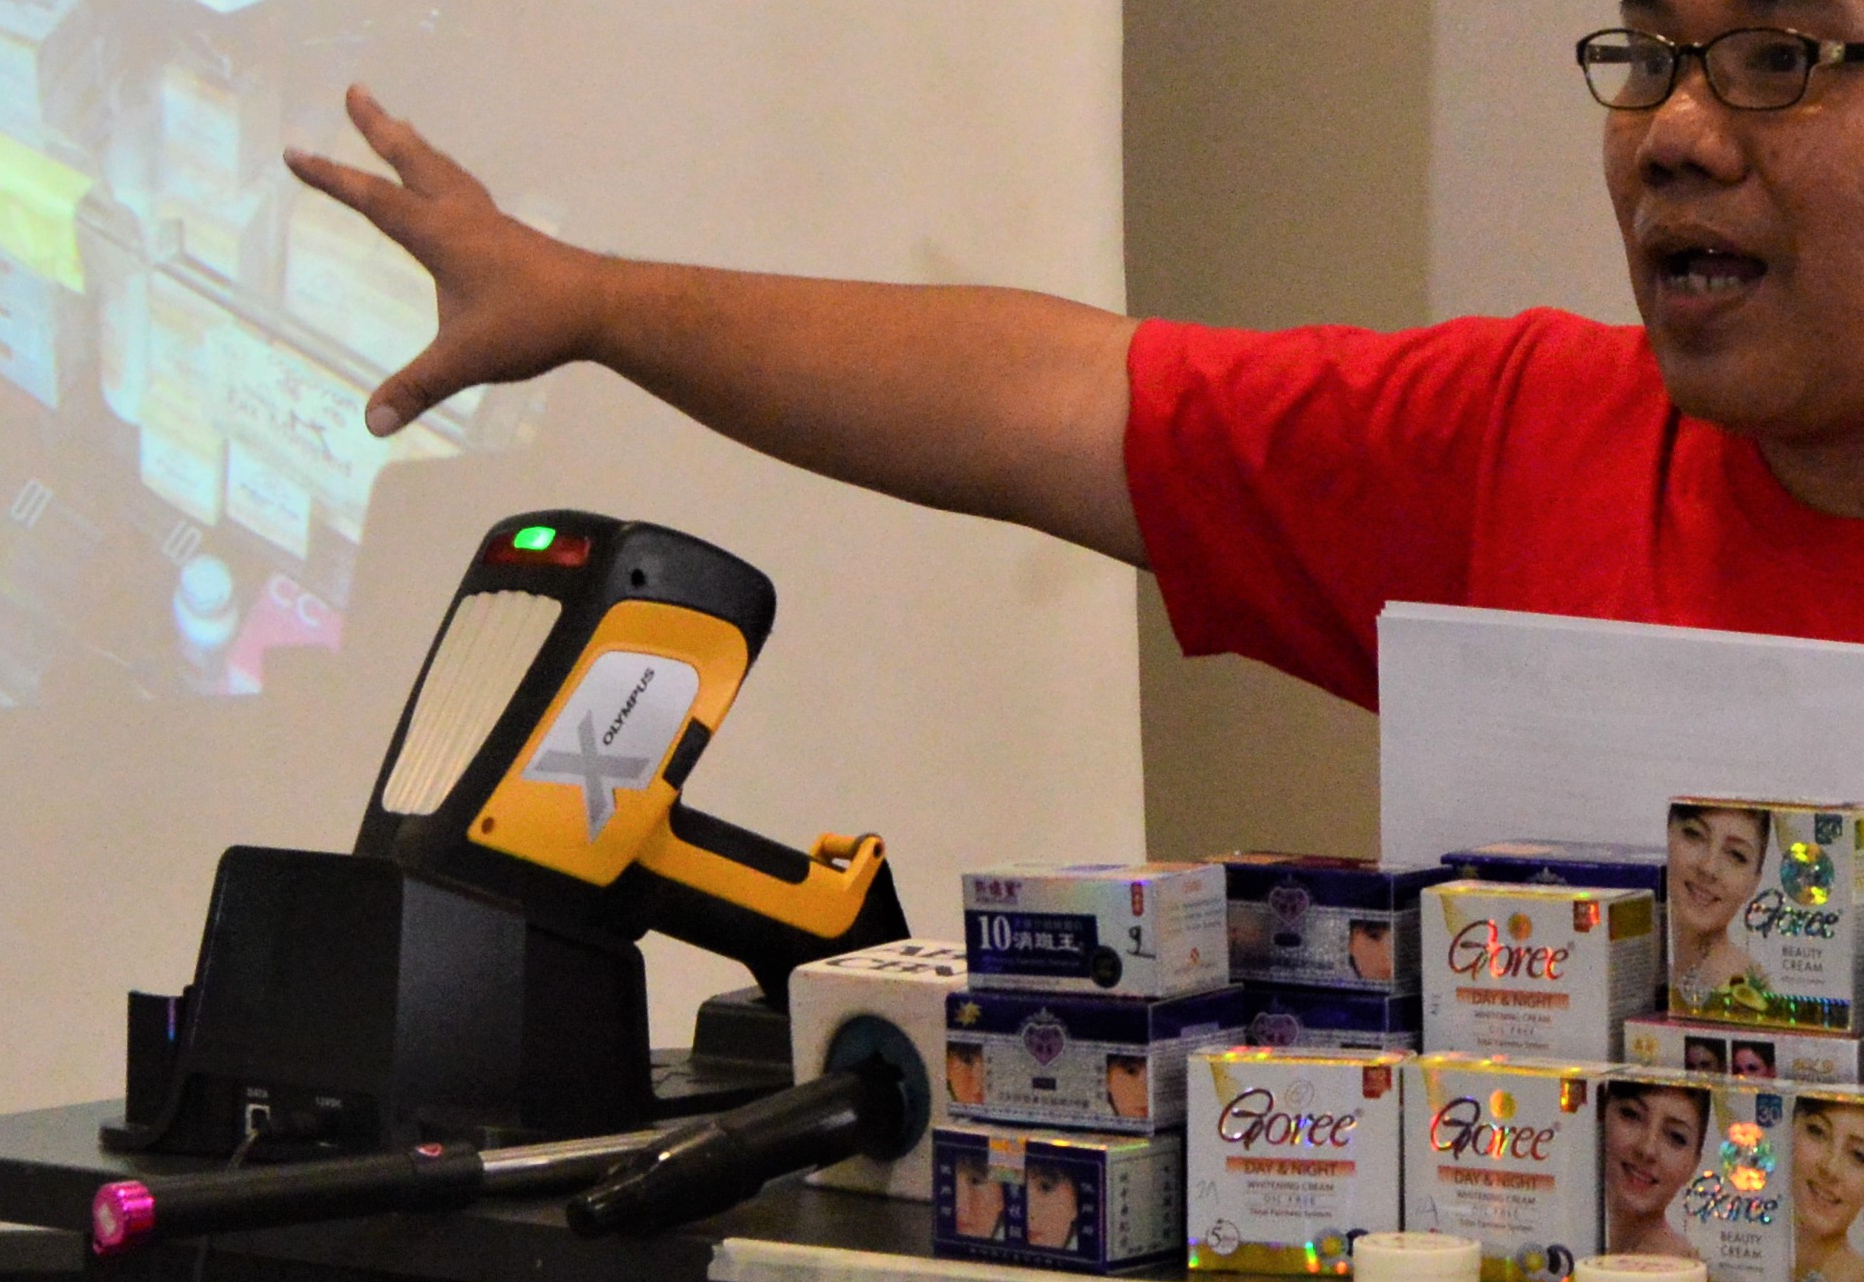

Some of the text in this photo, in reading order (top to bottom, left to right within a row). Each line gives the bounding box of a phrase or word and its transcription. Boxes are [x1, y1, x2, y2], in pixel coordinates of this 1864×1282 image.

[602, 667, 655, 746] OLYMPUS
[978, 915, 1012, 951] 10
[1449, 919, 1569, 981] Goree
[1219, 1088, 1357, 1150] Goree
[1430, 1097, 1554, 1160] Goree
